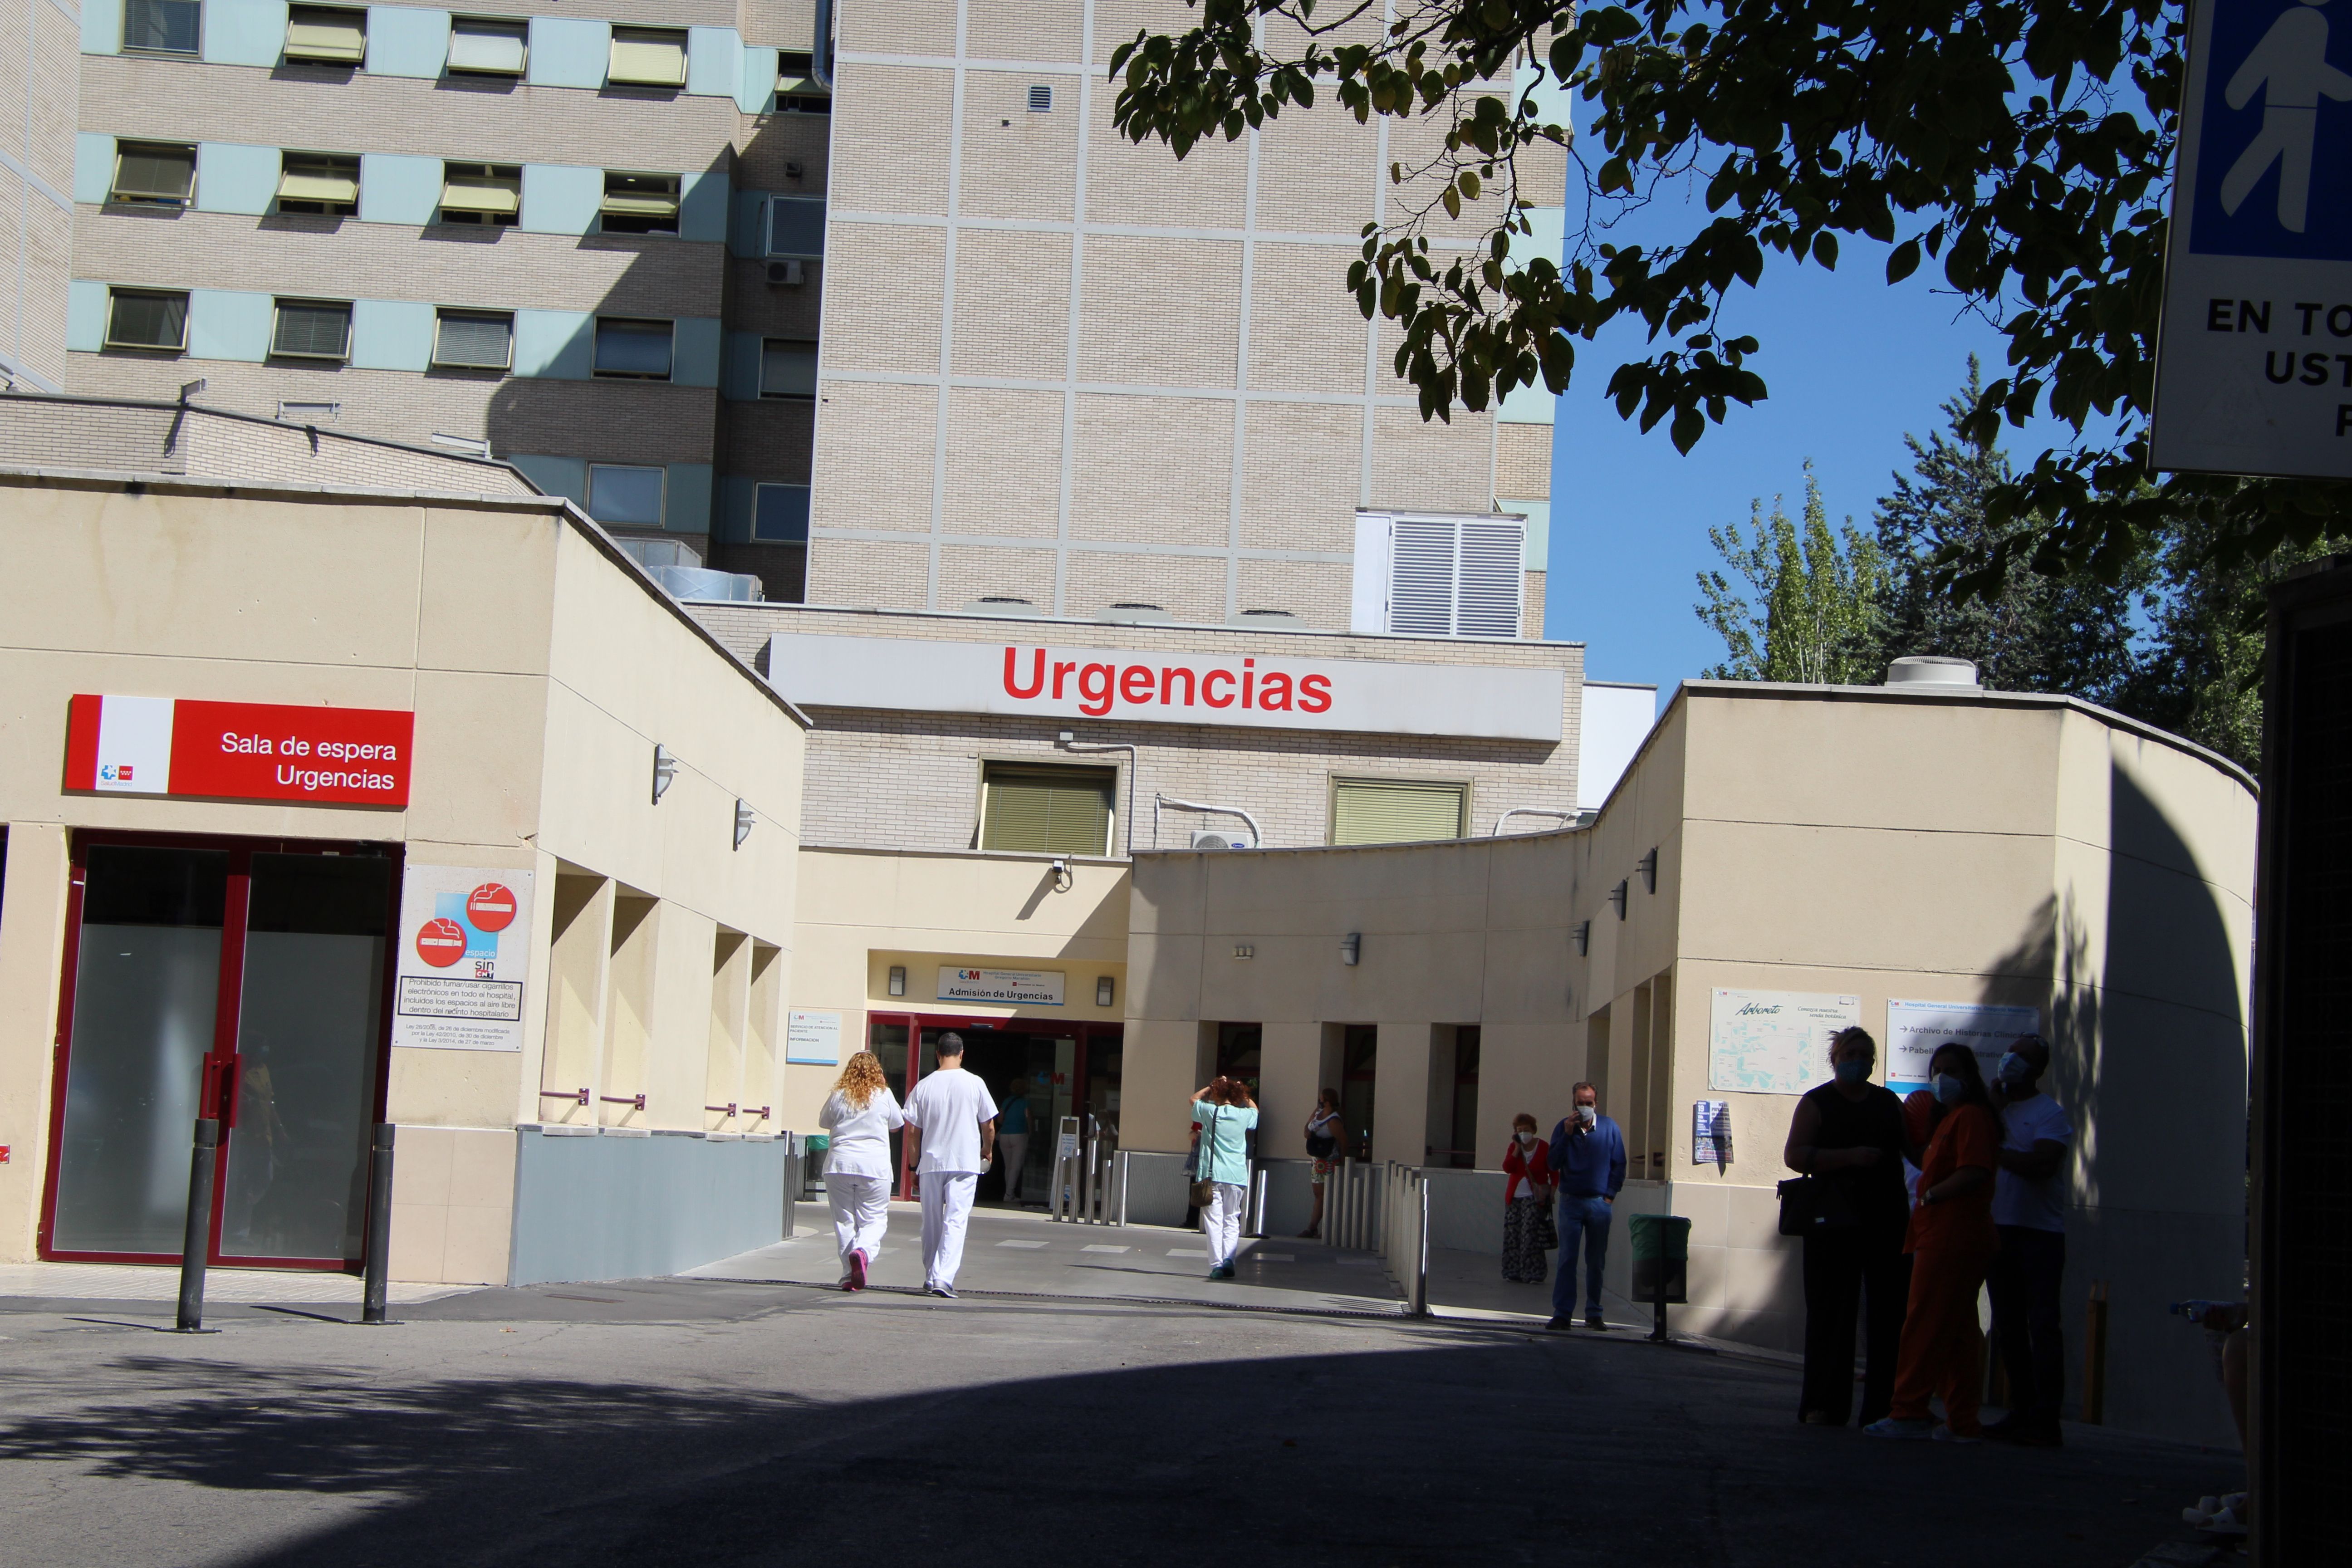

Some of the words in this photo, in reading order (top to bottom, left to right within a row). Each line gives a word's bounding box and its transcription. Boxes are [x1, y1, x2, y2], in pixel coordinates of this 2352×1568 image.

[2207, 299, 2271, 333] EN
[1003, 647, 1333, 716] Urgencias
[221, 732, 272, 754] Sala
[280, 736, 310, 756] de
[318, 742, 397, 763] espera
[277, 764, 395, 790] Urgencias
[465, 949, 495, 958] espacio
[475, 958, 494, 970] sin
[409, 978, 441, 986] Prohibido
[443, 980, 480, 988] fumar/usar
[404, 996, 434, 1004] incluidos
[408, 988, 449, 996] electrónicos
[486, 992, 515, 1000] hospital,
[949, 988, 990, 998] Admisión
[1007, 991, 1053, 1000] Urgencias
[470, 1009, 509, 1018] hospitalario
[1735, 1002, 1784, 1016] Arboreto
[1909, 1026, 1941, 1035] Archivo
[1955, 1029, 1991, 1038] Historias
